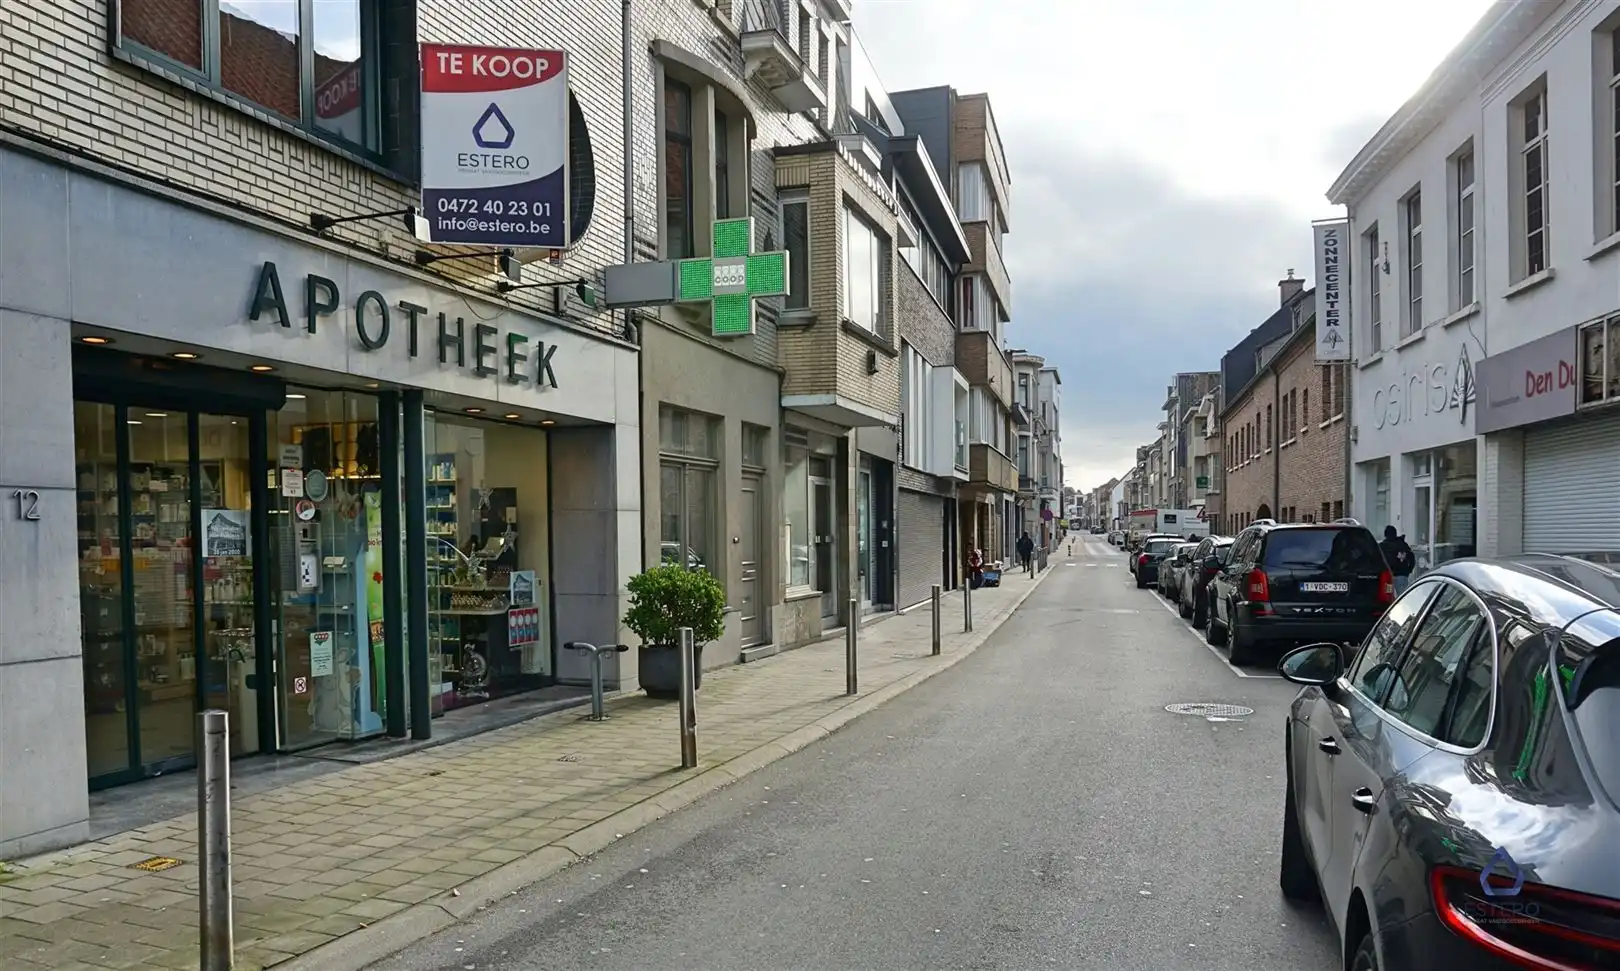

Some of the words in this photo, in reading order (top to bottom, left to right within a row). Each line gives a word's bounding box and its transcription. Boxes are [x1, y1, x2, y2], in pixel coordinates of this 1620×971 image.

[436, 52, 463, 75] TE
[472, 54, 549, 79] KOOP
[457, 153, 530, 170] ESTERO
[438, 198, 478, 213] 0472
[483, 200, 503, 214] 40
[508, 201, 528, 215] 23
[532, 202, 550, 217] 01
[437, 217, 551, 234] info@estero.be
[714, 275, 744, 285] coop
[1324, 228, 1340, 327] ZONNECENTER
[249, 261, 558, 389] APOTHEEK
[1373, 362, 1448, 430] osiris
[1525, 370, 1553, 398] Den
[13, 488, 41, 520] 12
